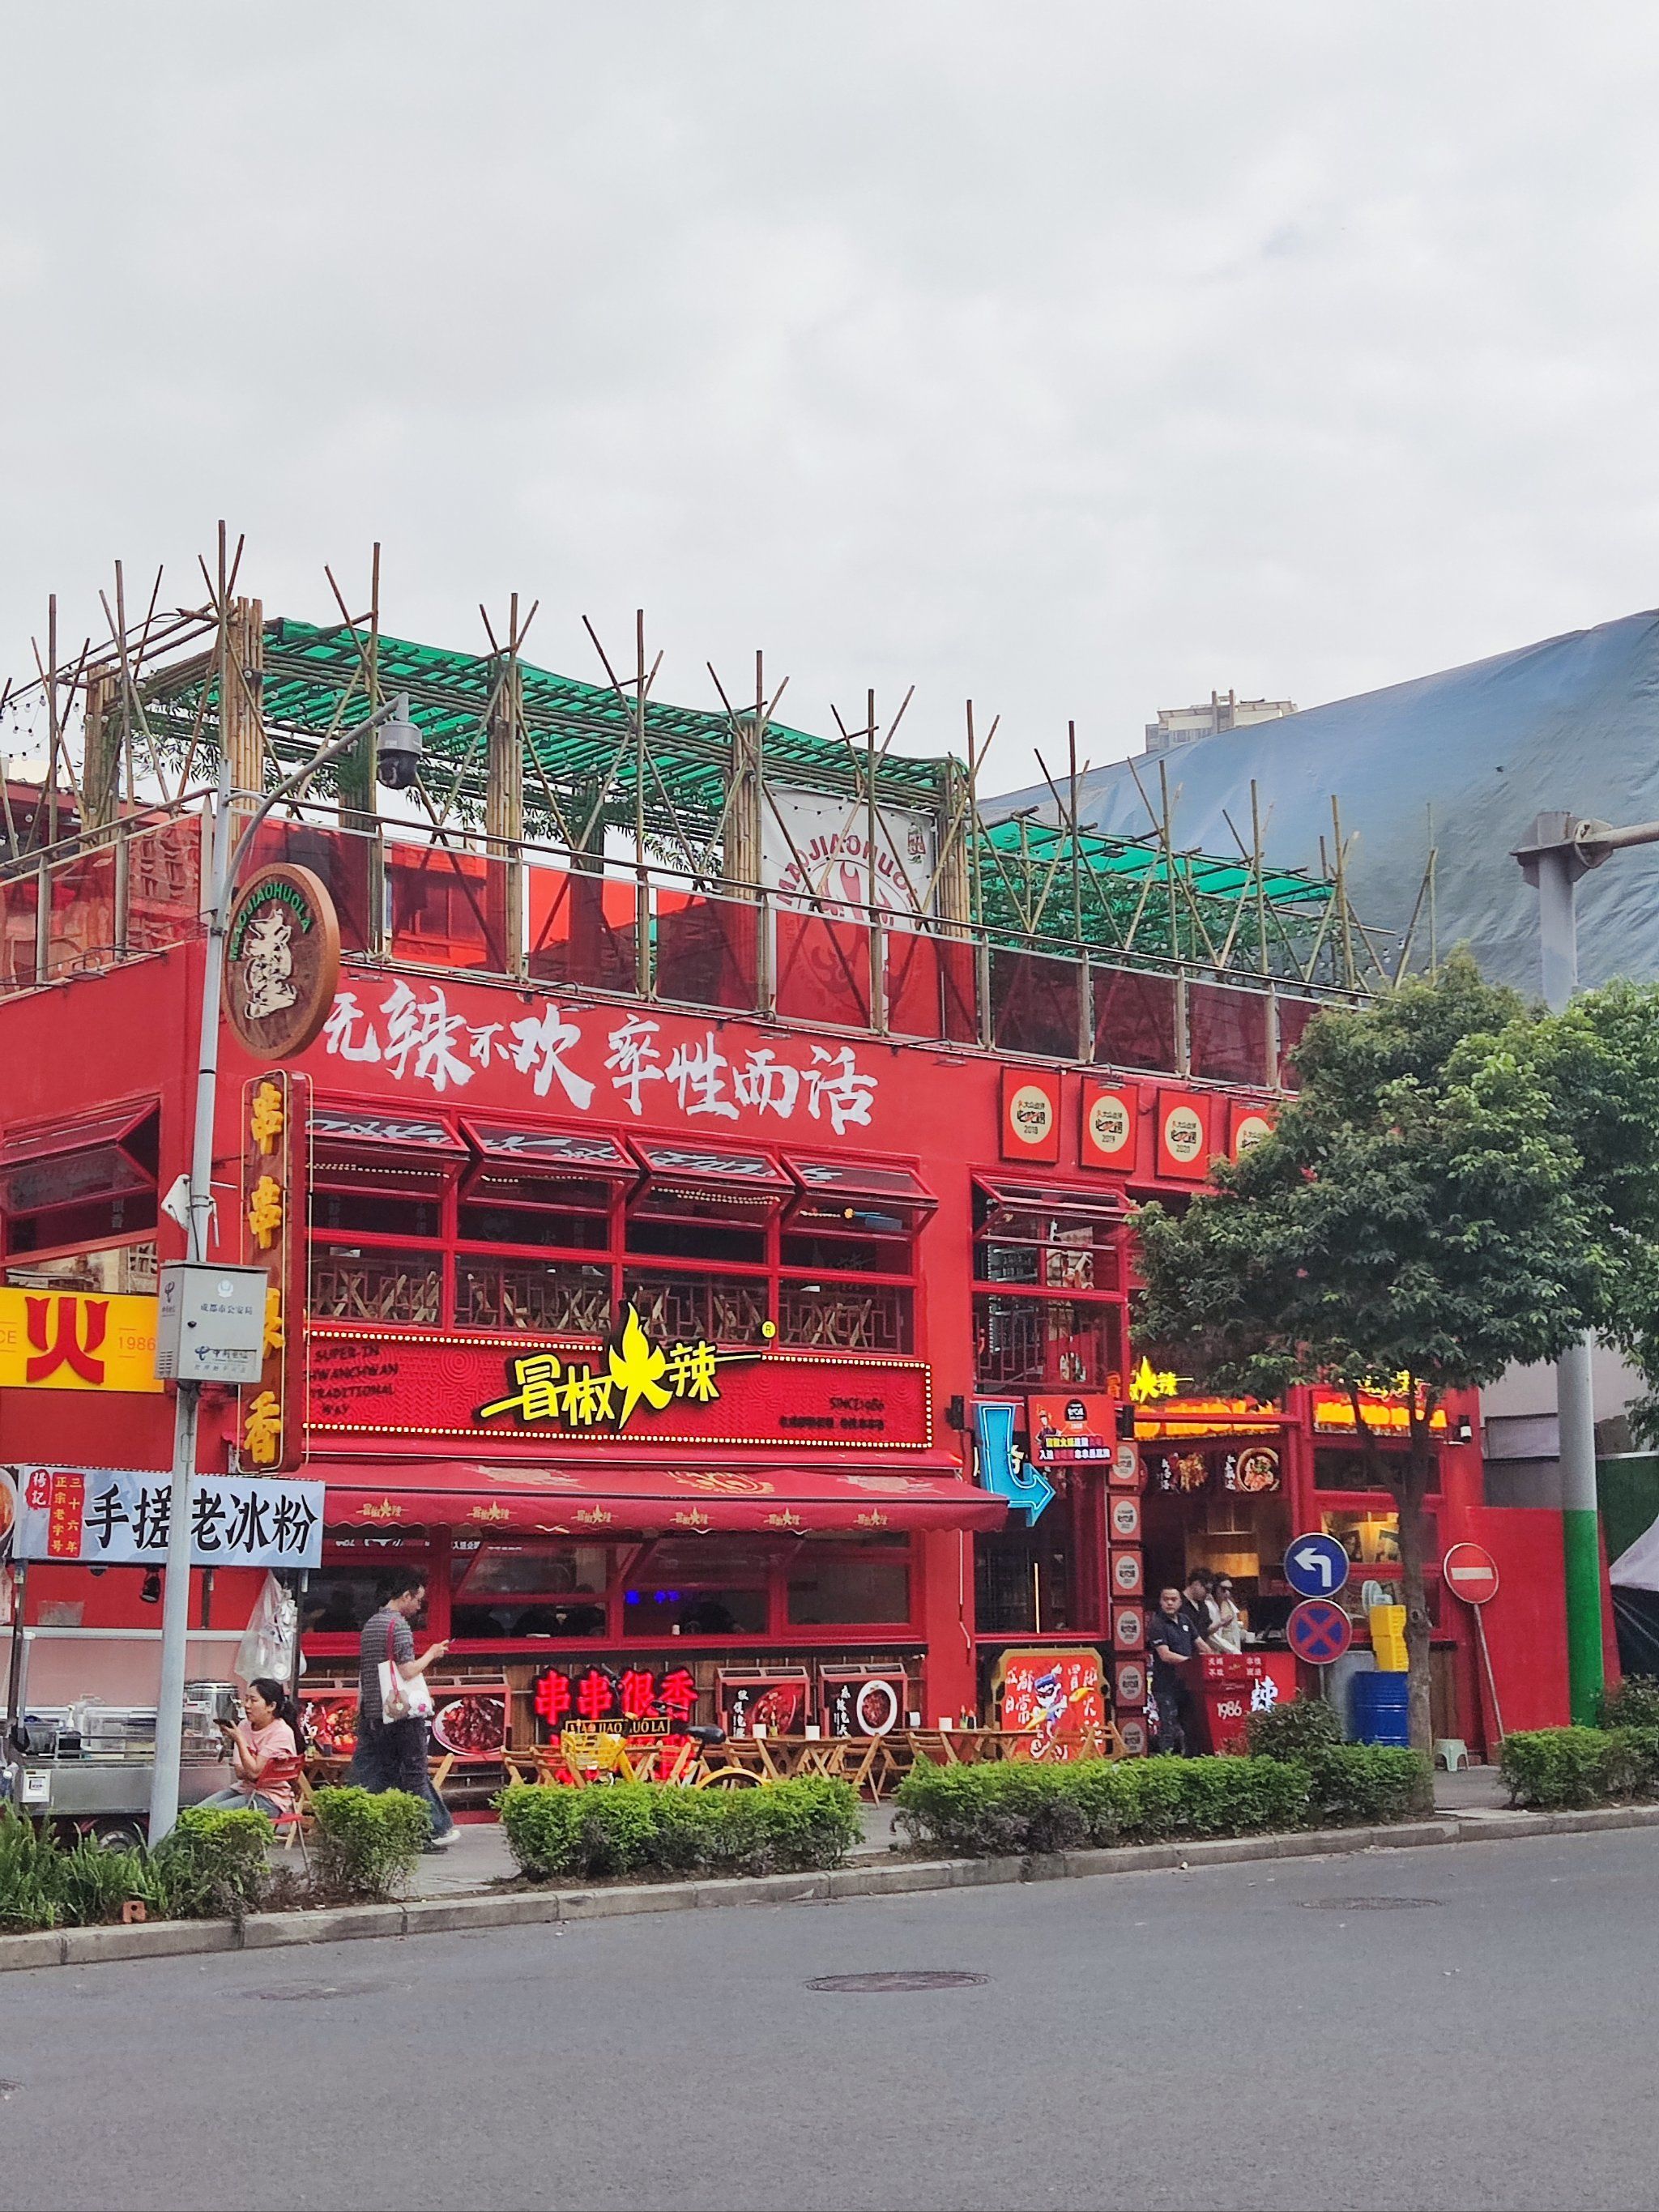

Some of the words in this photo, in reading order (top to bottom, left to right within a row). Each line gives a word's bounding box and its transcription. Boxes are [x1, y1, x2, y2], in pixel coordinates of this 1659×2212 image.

[604, 1013, 877, 1135] 率性而活
[25, 1296, 109, 1385] 火
[119, 1336, 156, 1352] 1986
[515, 1302, 720, 1430] 冒椒火辣
[84, 1484, 318, 1554] 手搓老冰粉
[535, 1669, 699, 1726] 串串很香
[651, 1720, 666, 1733] LA
[1217, 1700, 1243, 1720] 1986
